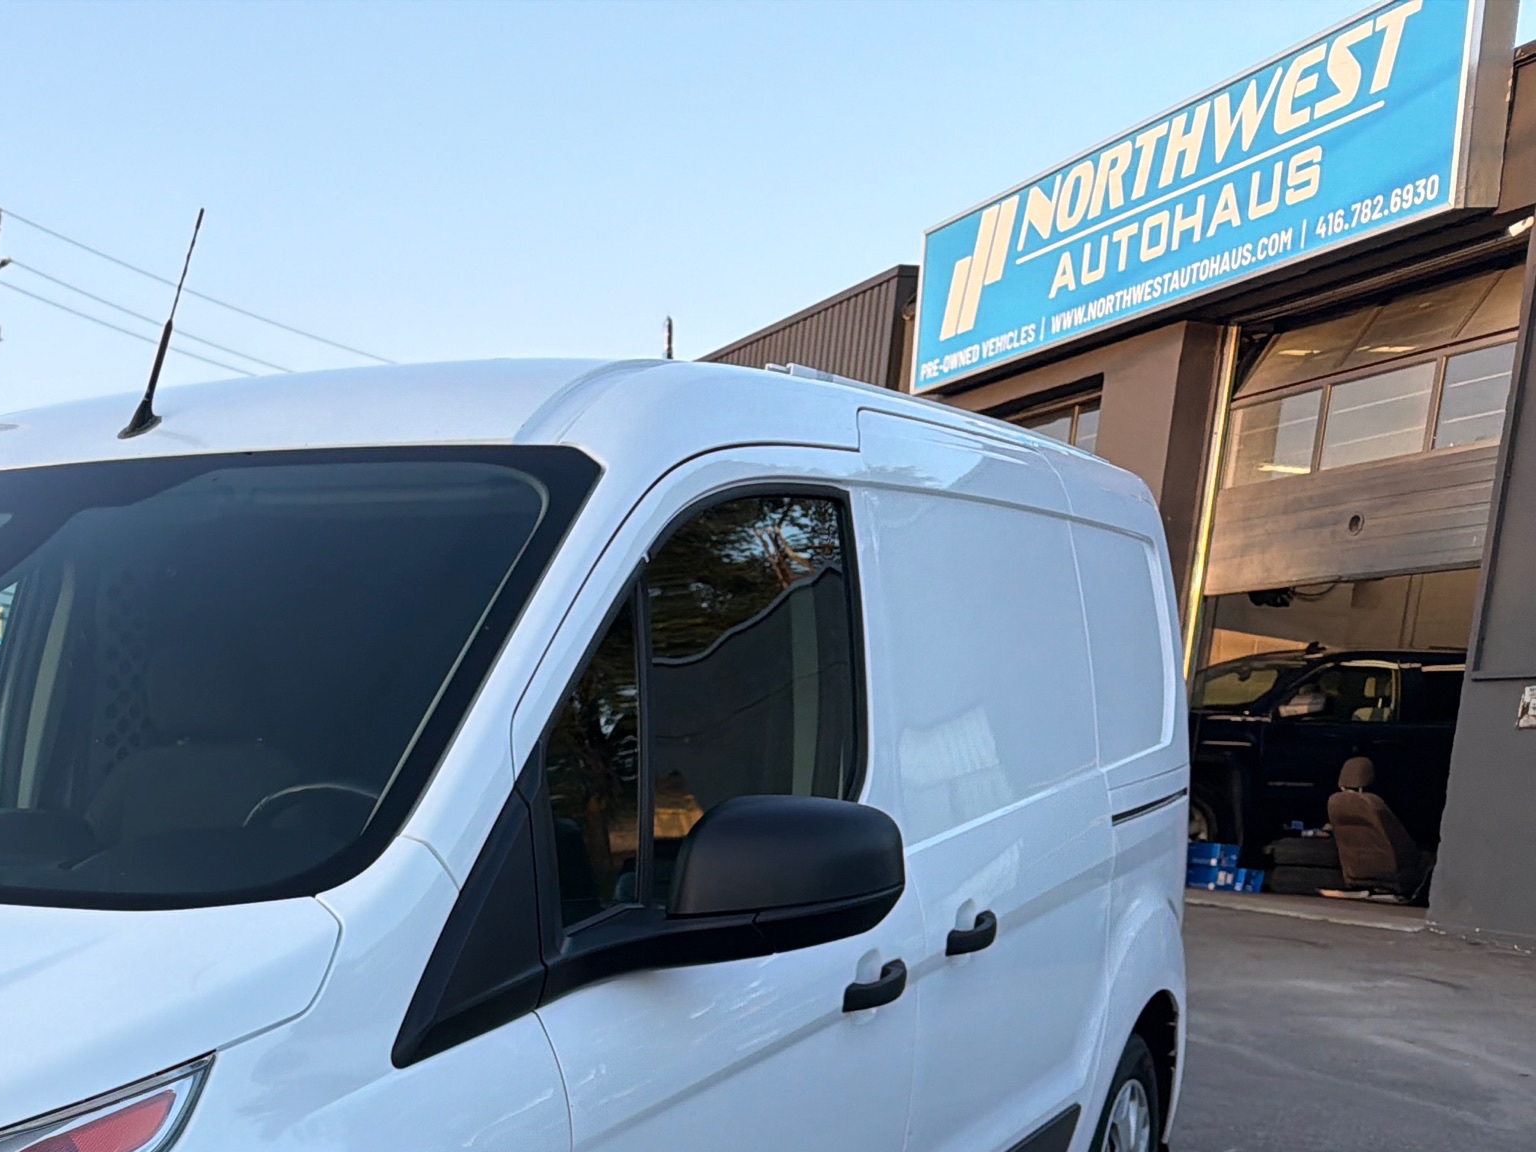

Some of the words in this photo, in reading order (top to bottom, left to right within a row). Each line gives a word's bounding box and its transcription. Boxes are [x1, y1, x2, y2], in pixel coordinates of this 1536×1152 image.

[1017, 0, 1424, 252] NORTHWEST
[1048, 145, 1323, 299] AUTOHAUS
[920, 345, 980, 382] PRE-OWNED
[981, 323, 1037, 360] VEHICLES
[1050, 227, 1293, 335] WWW.NORTHWESTAUTOHAUS.COM
[1315, 174, 1440, 240] 416.782.6930
